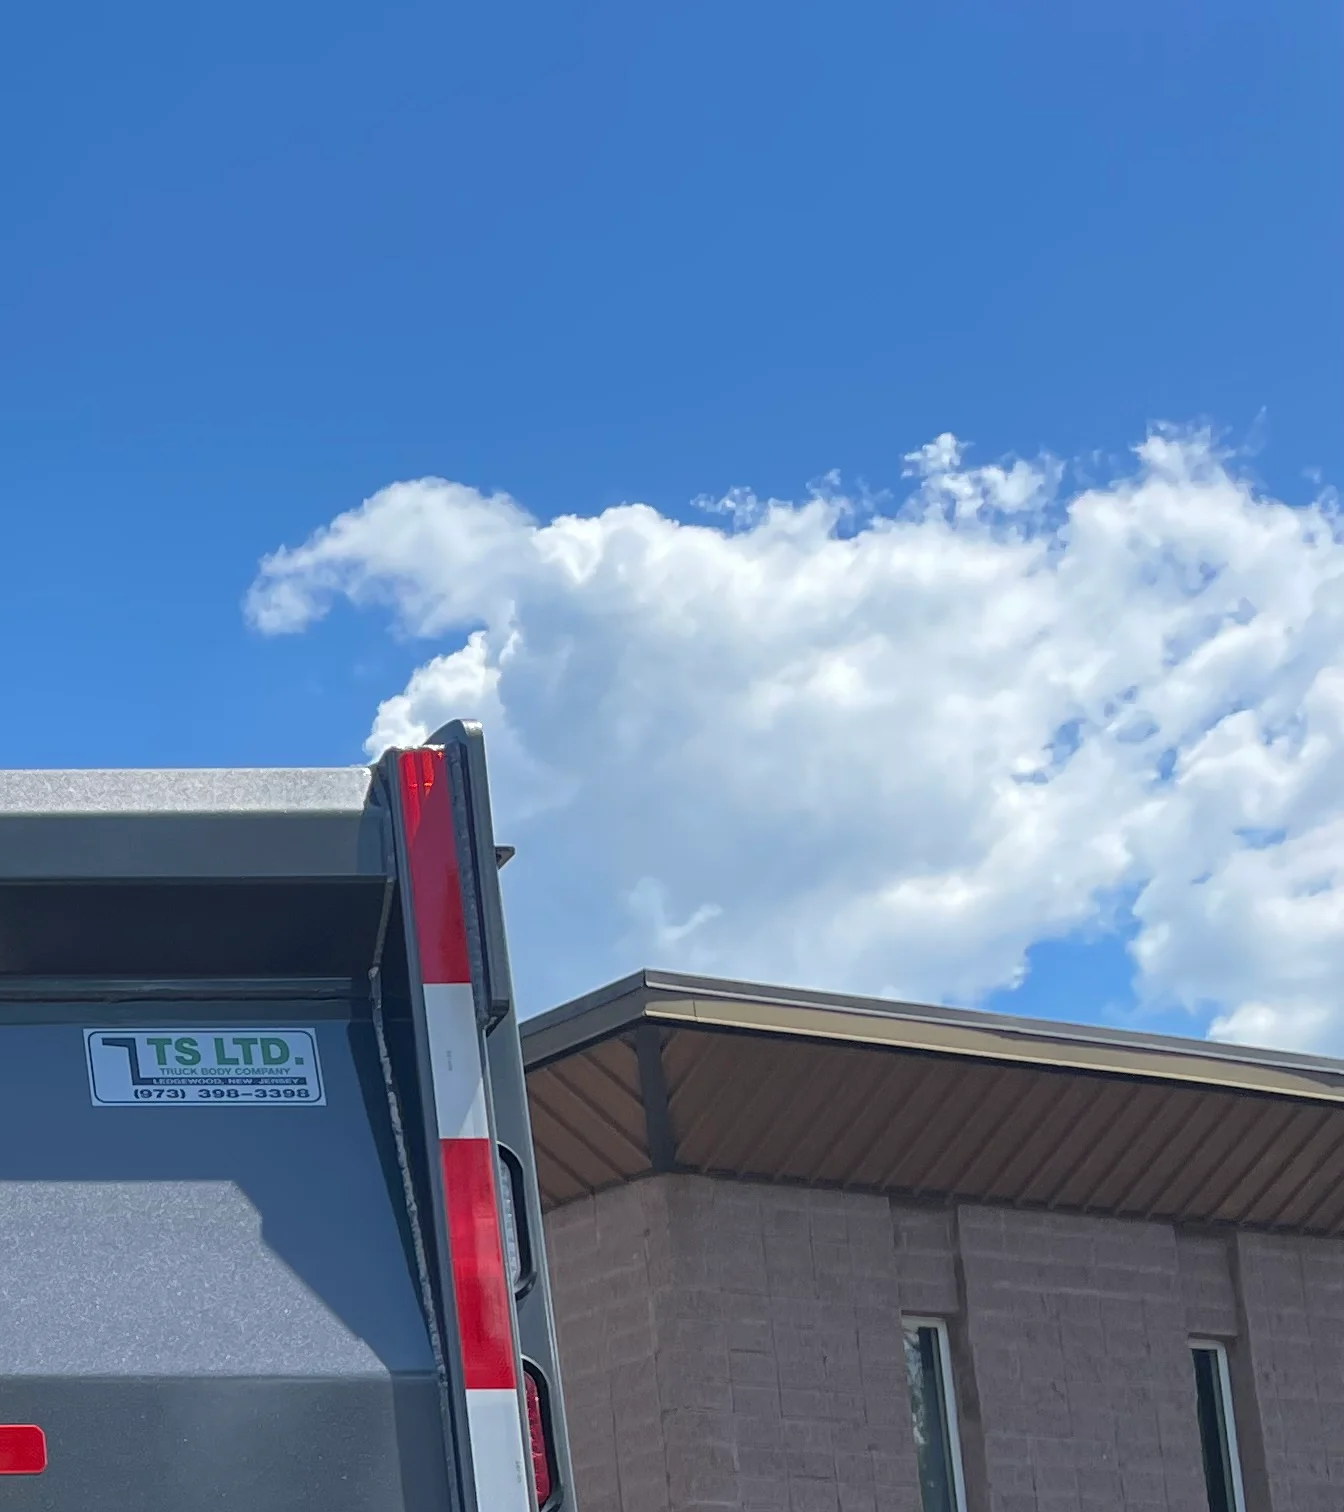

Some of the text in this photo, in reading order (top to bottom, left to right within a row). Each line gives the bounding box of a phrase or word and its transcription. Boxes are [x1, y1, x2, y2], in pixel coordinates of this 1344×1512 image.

[147, 1037, 305, 1066] TS LTD.
[161, 1067, 291, 1076] TRUCK BODY COMPANY
[228, 1077, 253, 1085] NEW
[133, 1088, 310, 1099] (973) 398-3398
